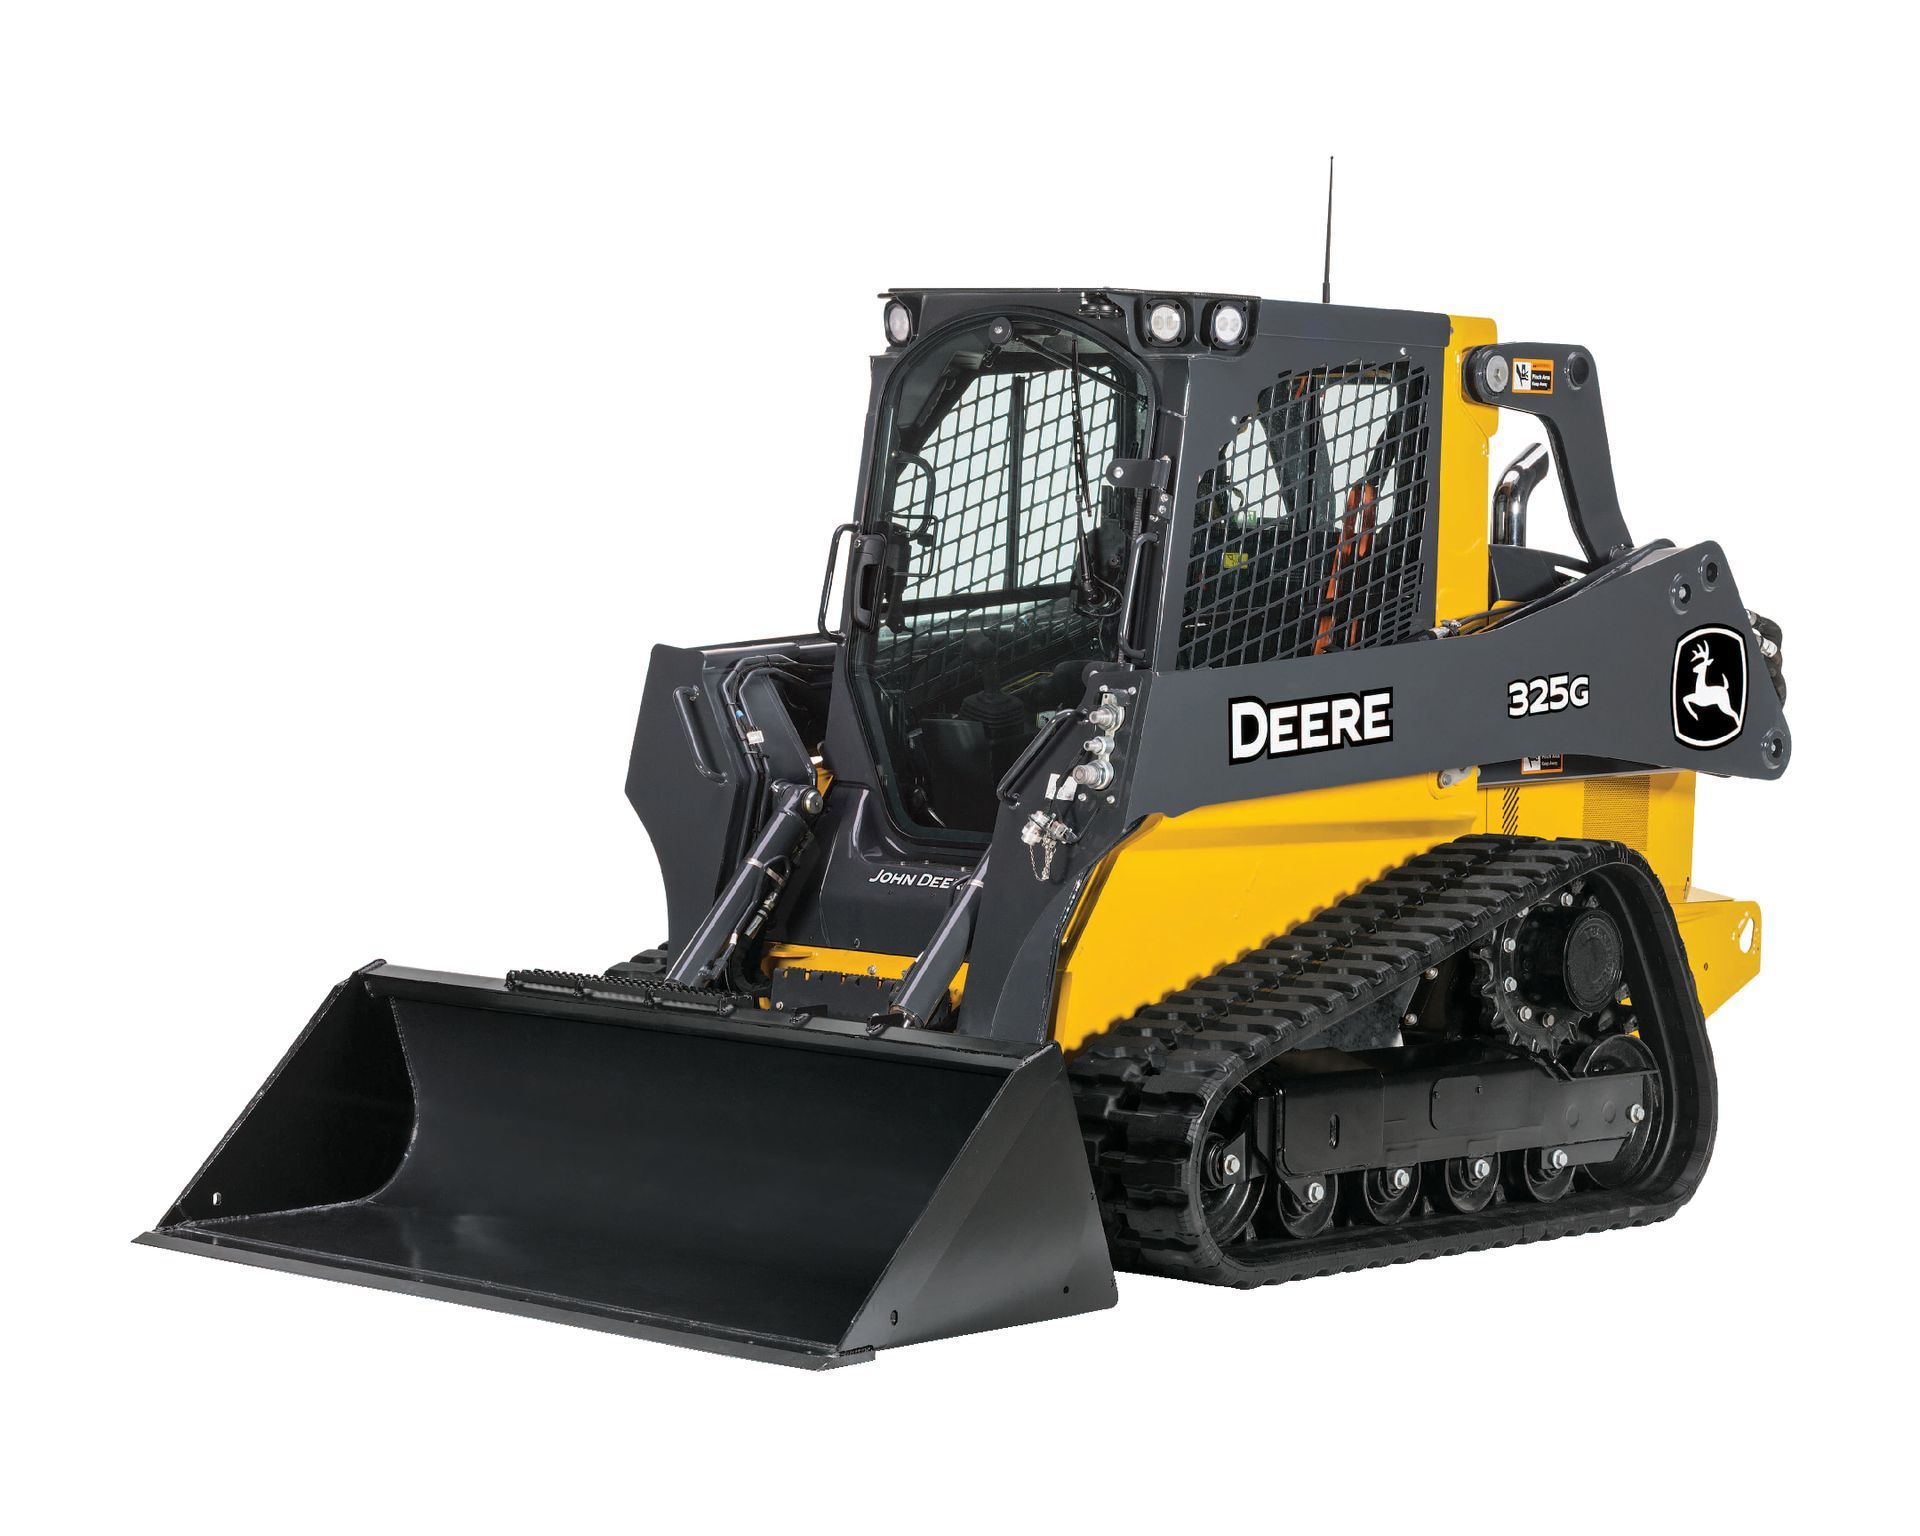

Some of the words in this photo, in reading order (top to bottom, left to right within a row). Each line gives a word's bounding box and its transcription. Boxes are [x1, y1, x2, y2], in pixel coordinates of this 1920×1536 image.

[1509, 675, 1589, 716] 325G
[1231, 692, 1390, 759] DEERE
[868, 868, 917, 886] JOHN
[916, 873, 962, 890] DEE
